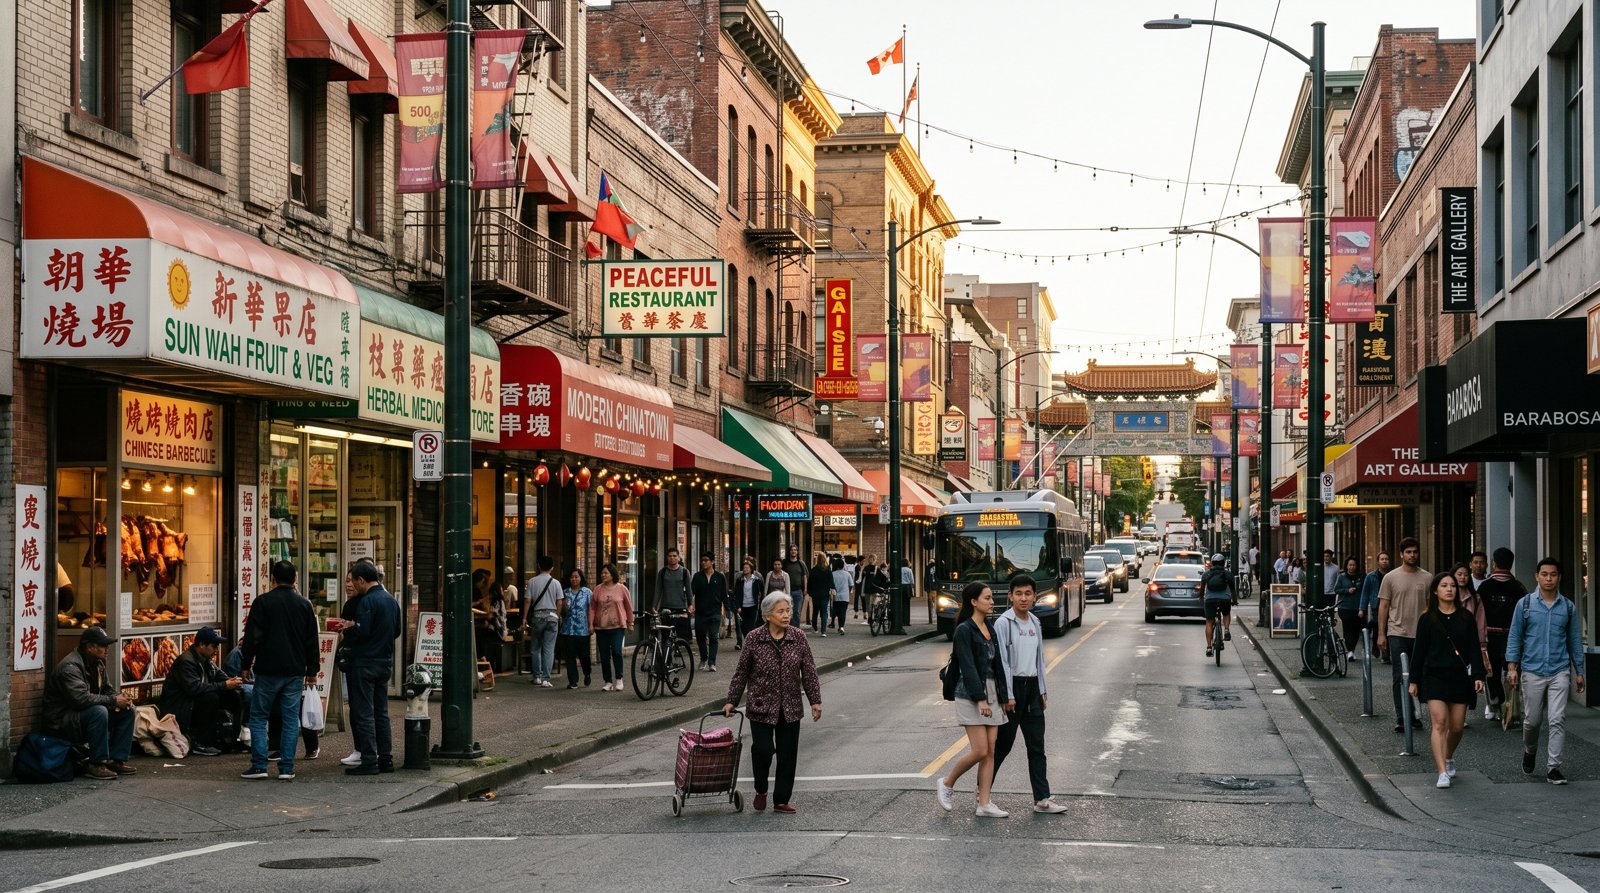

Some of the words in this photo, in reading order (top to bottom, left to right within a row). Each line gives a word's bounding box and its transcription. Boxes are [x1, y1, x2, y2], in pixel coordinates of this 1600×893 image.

[410, 106, 431, 117] 500
[1450, 194, 1467, 251] GALLERY
[610, 267, 717, 288] PEACEFUL
[1451, 255, 1467, 279] ART
[609, 291, 718, 308] RESTAURANT
[1451, 282, 1467, 304] THE
[211, 270, 317, 346] 新華果店
[830, 287, 847, 371] GAISEE
[165, 318, 200, 357] SUN
[204, 328, 241, 367] WAH
[247, 338, 289, 376] FRUIT
[292, 354, 302, 380] &
[306, 355, 334, 386] VEG
[500, 383, 551, 406] 香碗
[1447, 374, 1482, 426] BARABOSA
[125, 398, 214, 442] 燒烤燒肉店
[367, 386, 409, 418] HERBAL
[471, 409, 494, 433] TORE
[567, 387, 614, 428] MODERN
[615, 401, 669, 442] CHINATOWN
[1504, 411, 1600, 426] BARABOSA
[125, 439, 164, 459] CHINESE
[1392, 448, 1419, 460] THE
[1364, 464, 1395, 476] ART
[1399, 463, 1469, 476] GALLERY
